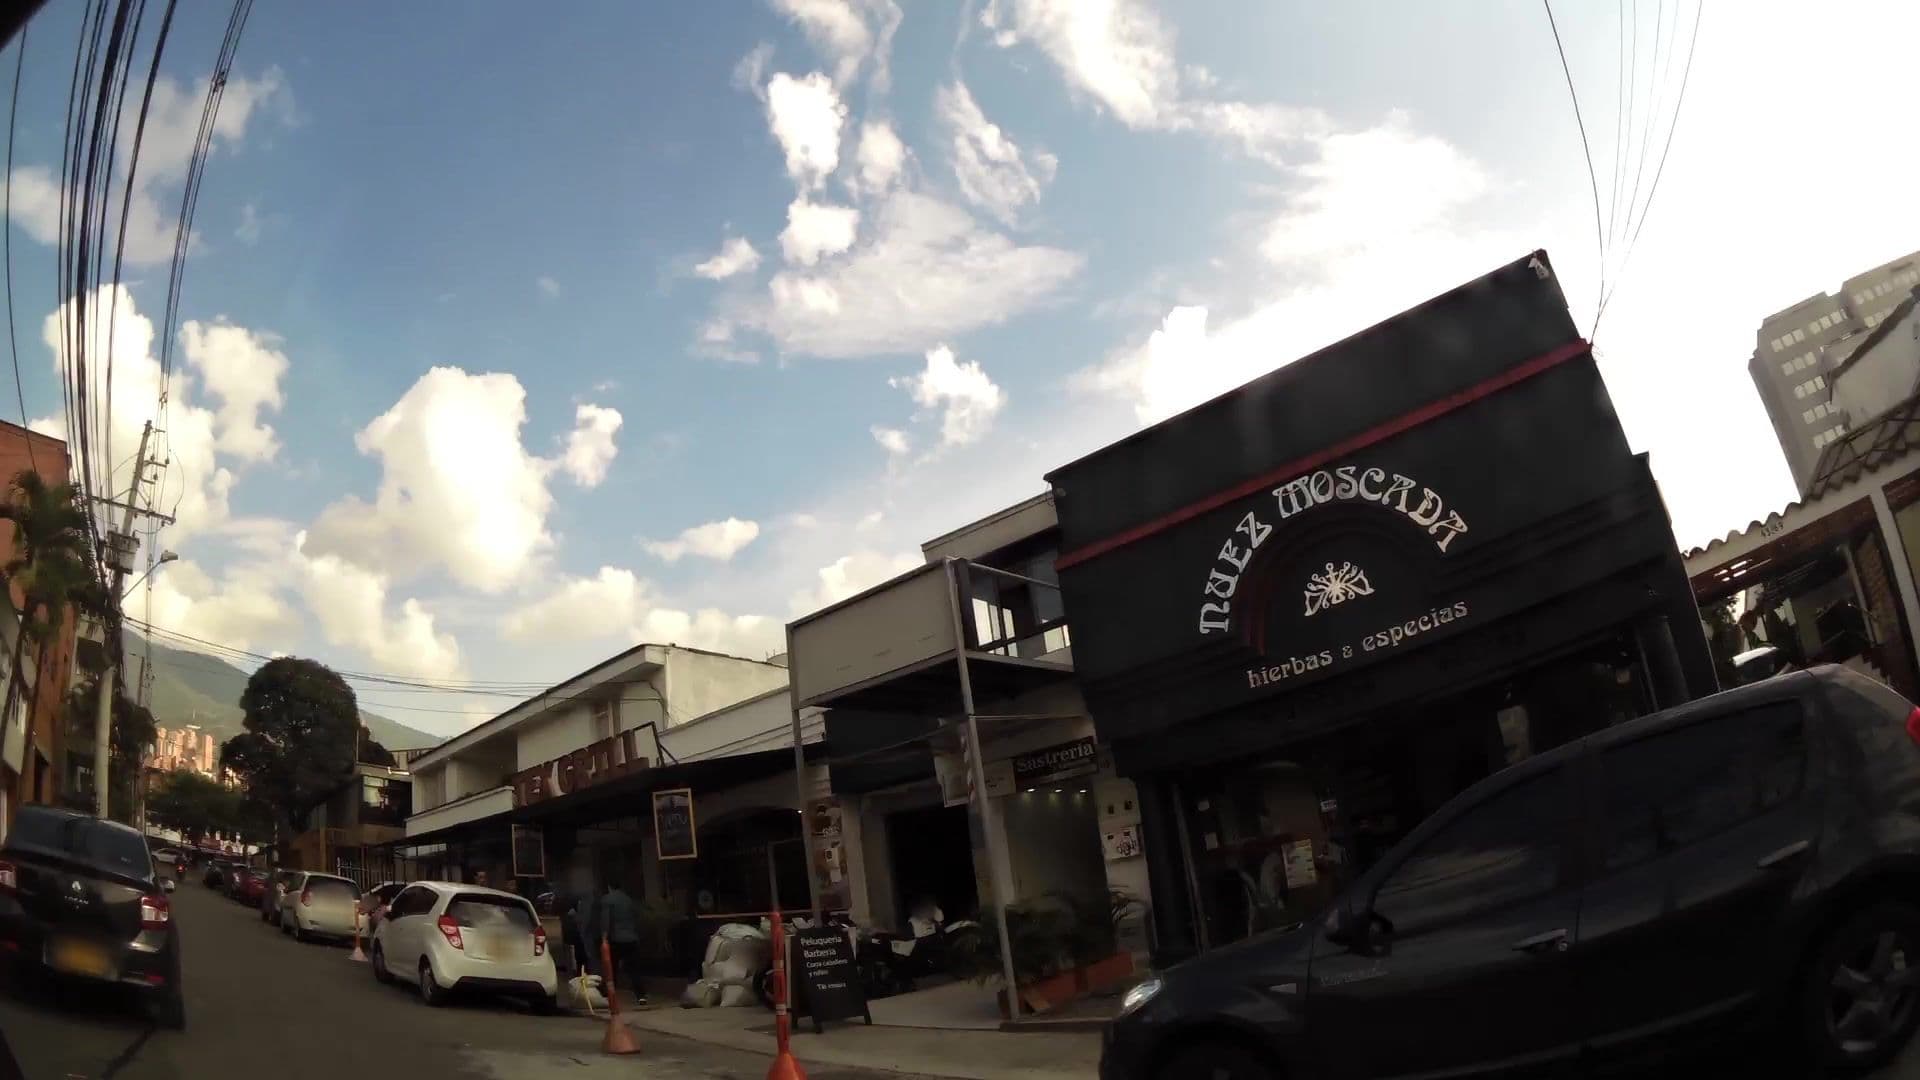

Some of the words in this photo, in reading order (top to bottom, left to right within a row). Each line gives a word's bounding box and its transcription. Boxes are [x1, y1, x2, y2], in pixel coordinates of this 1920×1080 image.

[1199, 511, 1273, 634] NUEZ
[1272, 466, 1469, 553] MOSCADA
[1246, 649, 1334, 689] hierbas
[1342, 645, 1353, 659] &
[1362, 601, 1469, 652] especias
